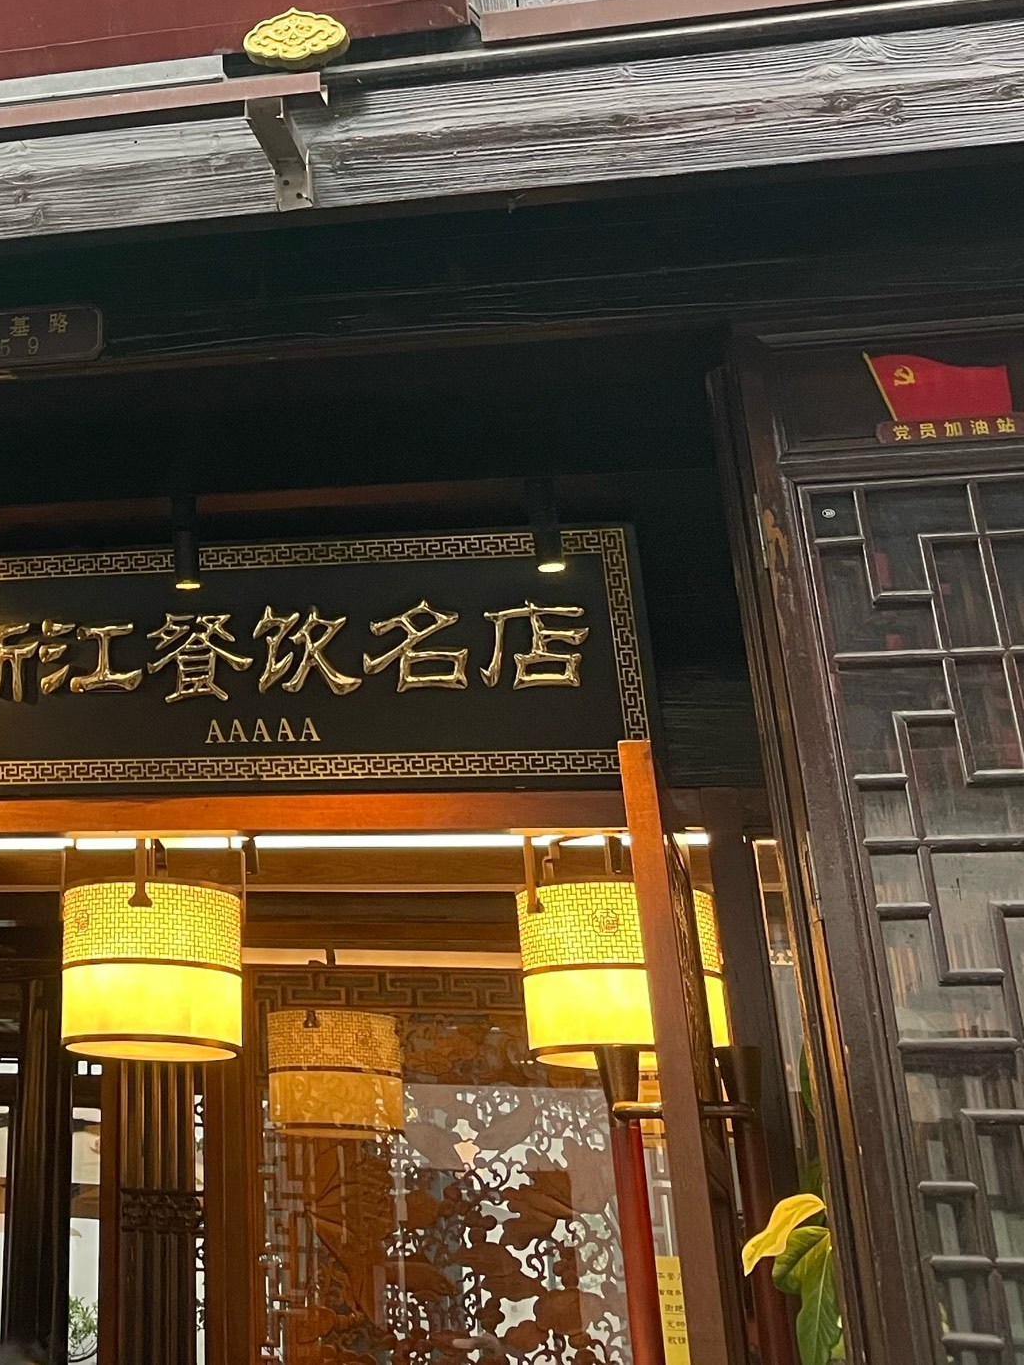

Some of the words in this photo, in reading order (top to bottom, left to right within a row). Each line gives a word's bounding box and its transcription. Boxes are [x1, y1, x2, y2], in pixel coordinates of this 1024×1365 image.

[892, 417, 1016, 442] 党员加油站
[205, 716, 322, 744] AAAAA
